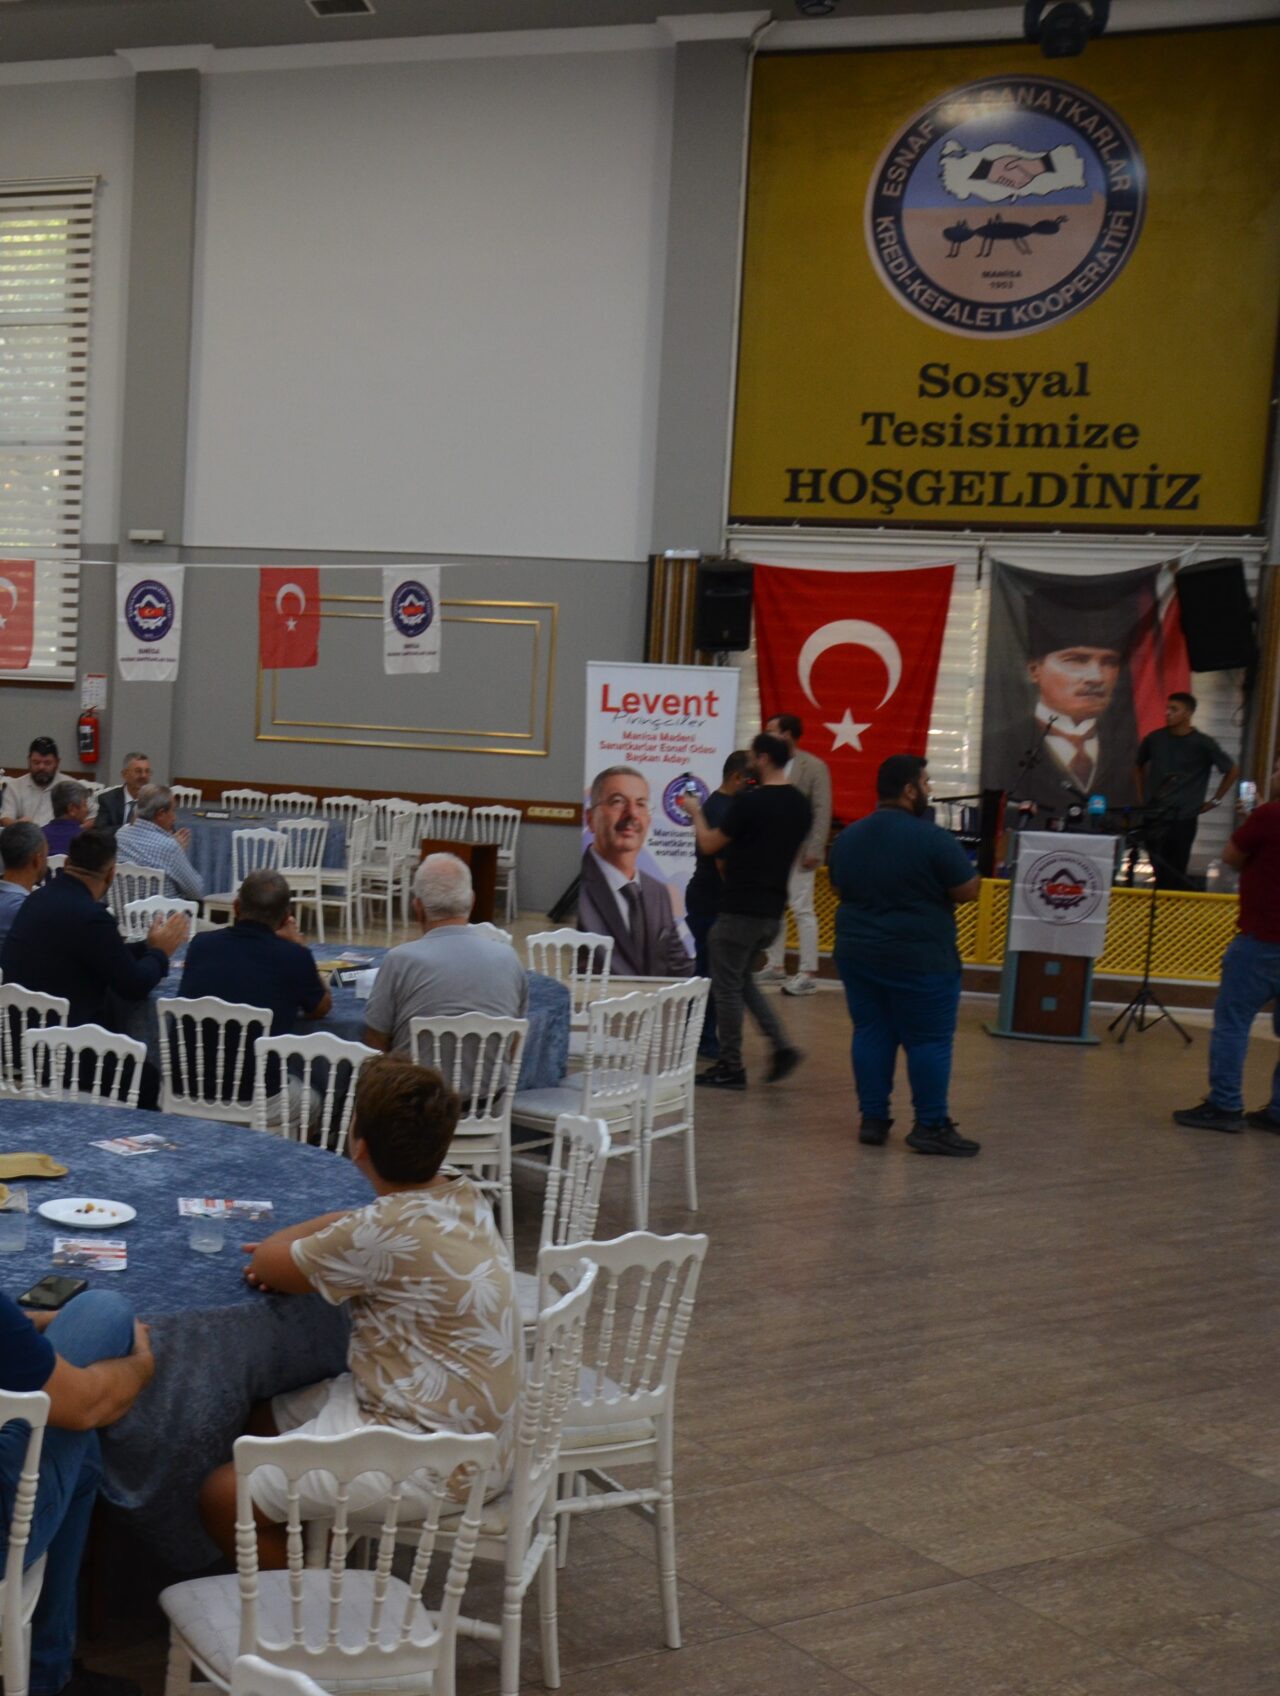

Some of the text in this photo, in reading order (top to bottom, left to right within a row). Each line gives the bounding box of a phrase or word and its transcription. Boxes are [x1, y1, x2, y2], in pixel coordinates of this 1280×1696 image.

[882, 120, 937, 198] ESNAF
[875, 210, 1134, 327] KREDİ-KEFALET KOOPERATİFİ
[918, 362, 1090, 407] Sosyal
[862, 412, 1141, 450] Tesisimize
[784, 462, 1202, 515] HOŞGELDİNİZ
[600, 683, 719, 717] Levent
